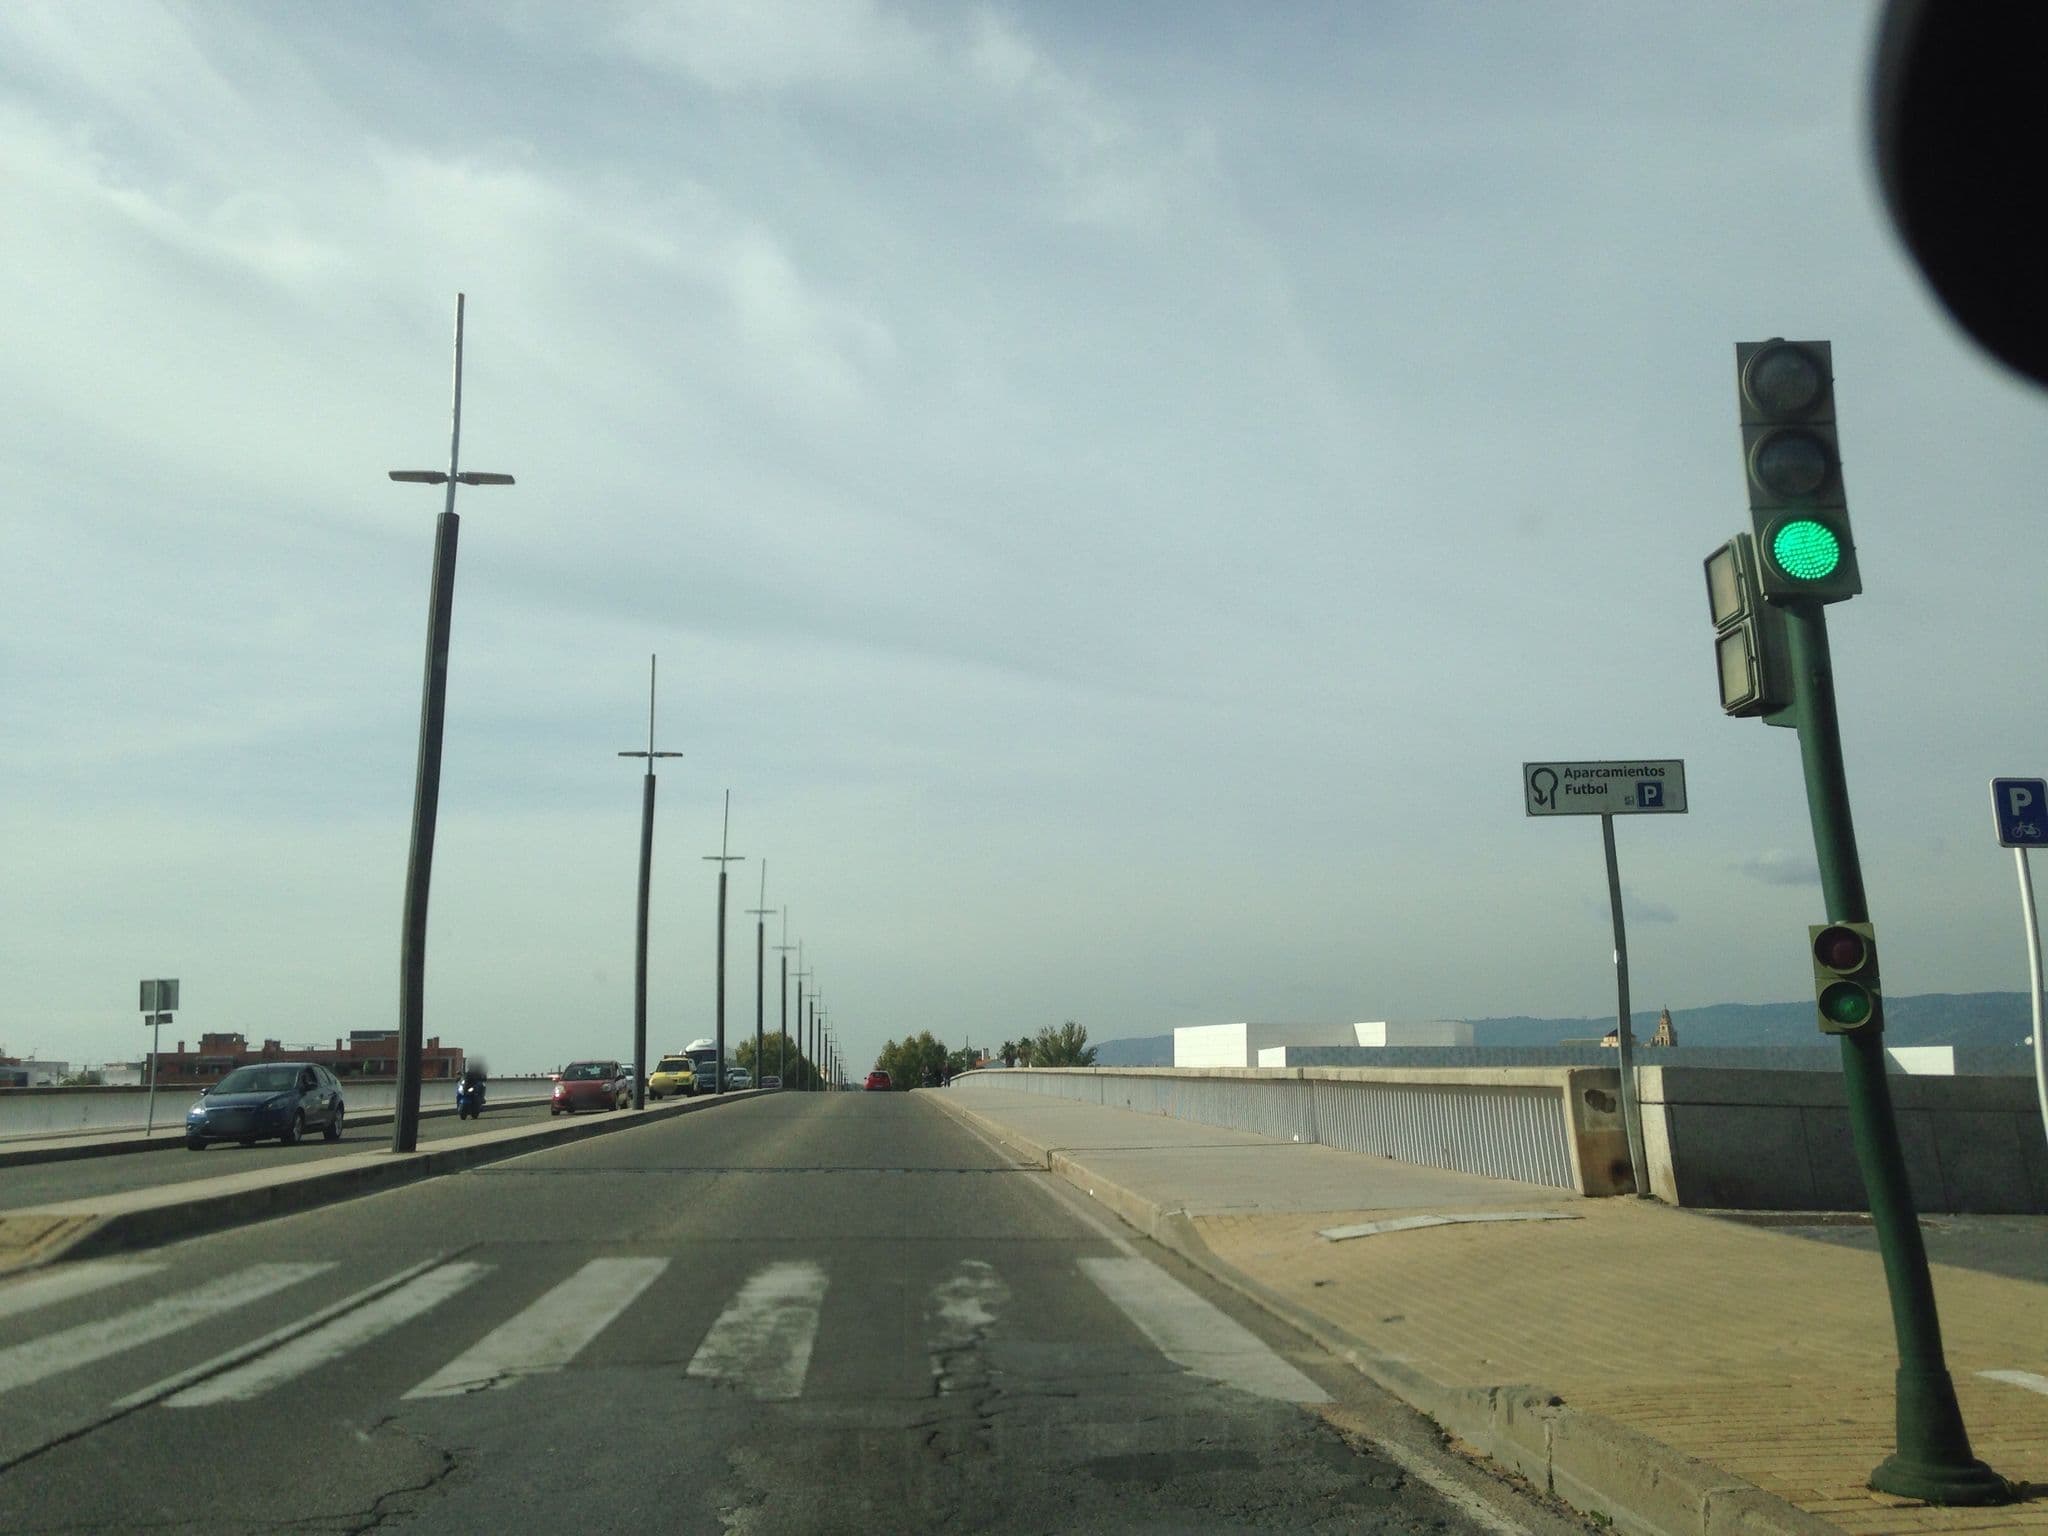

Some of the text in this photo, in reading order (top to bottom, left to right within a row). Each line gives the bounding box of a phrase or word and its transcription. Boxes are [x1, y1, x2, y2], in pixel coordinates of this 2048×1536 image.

[1564, 766, 1666, 780] Aparcamientos
[1565, 783, 1608, 795] Futbol
[1644, 786, 1657, 805] P
[2009, 787, 2033, 816] P
